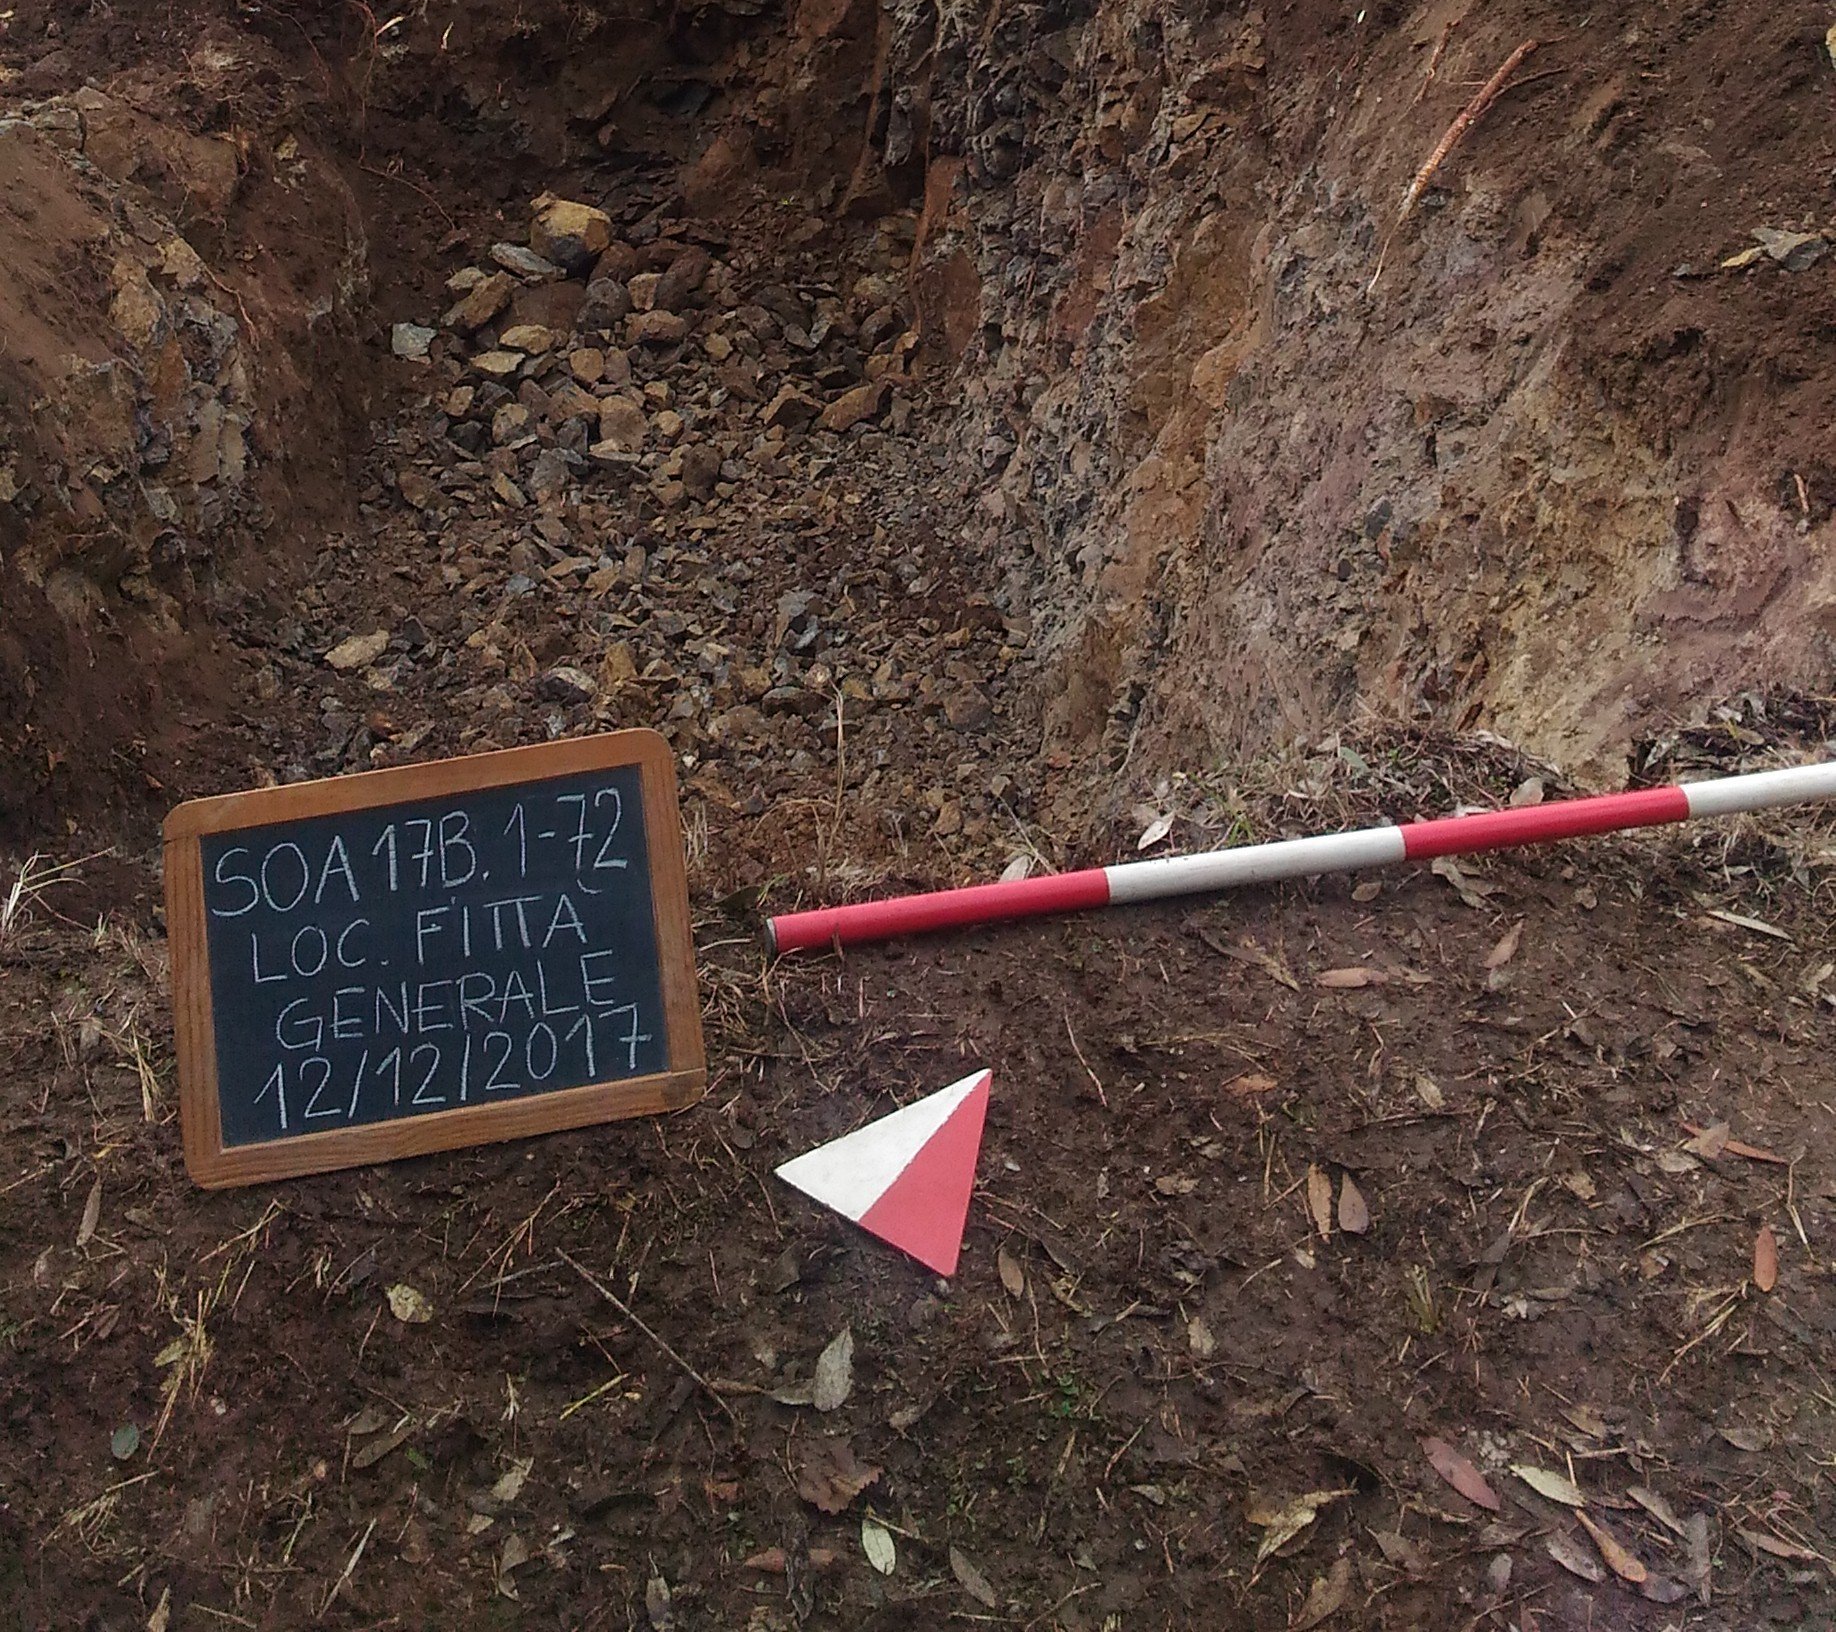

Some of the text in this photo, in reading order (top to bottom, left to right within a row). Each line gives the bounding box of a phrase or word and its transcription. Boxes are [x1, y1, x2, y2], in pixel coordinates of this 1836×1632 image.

[252, 893, 588, 983] LOC. FITTA
[276, 950, 615, 1052] GENERALE
[253, 1003, 653, 1130] 12/12/2017
